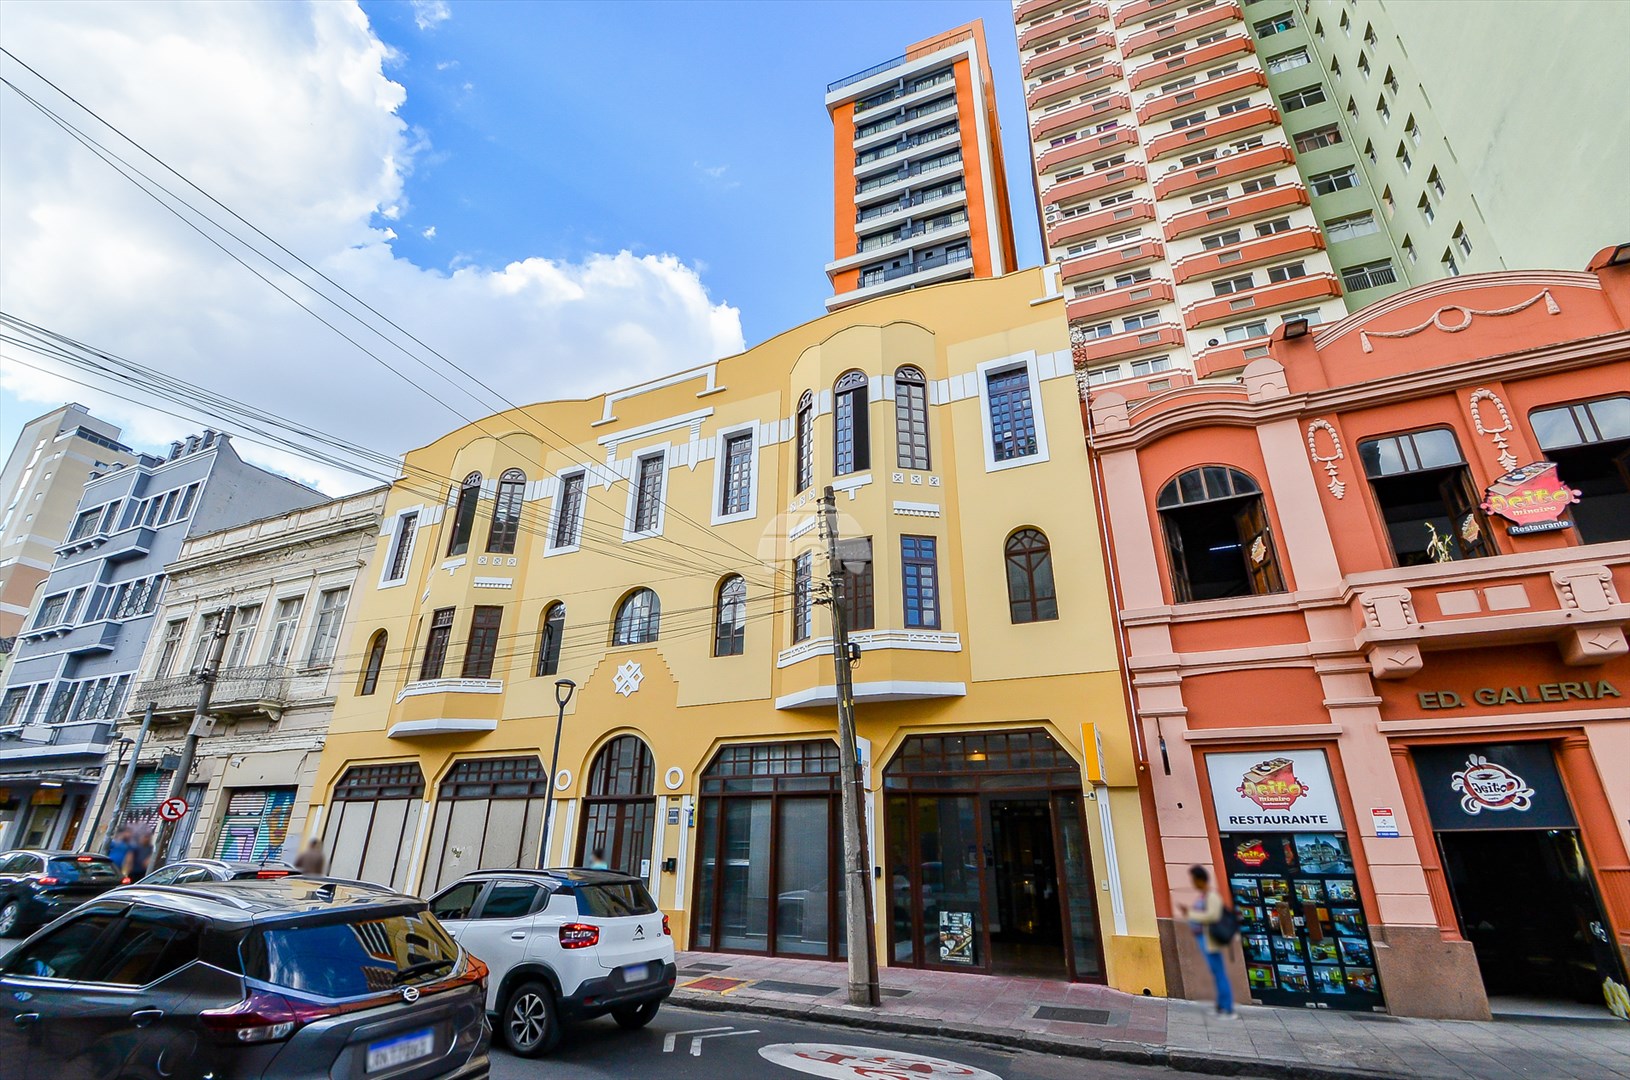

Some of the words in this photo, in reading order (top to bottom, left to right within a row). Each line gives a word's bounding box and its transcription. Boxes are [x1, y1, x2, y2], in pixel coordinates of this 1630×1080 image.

[1511, 520, 1569, 533] Restaurante
[1417, 691, 1466, 710] ED.
[1474, 679, 1621, 706] GALERIA
[1244, 779, 1302, 797] Jeito
[1471, 782, 1507, 794] Jeito
[1229, 815, 1329, 825] RESTAURANTE
